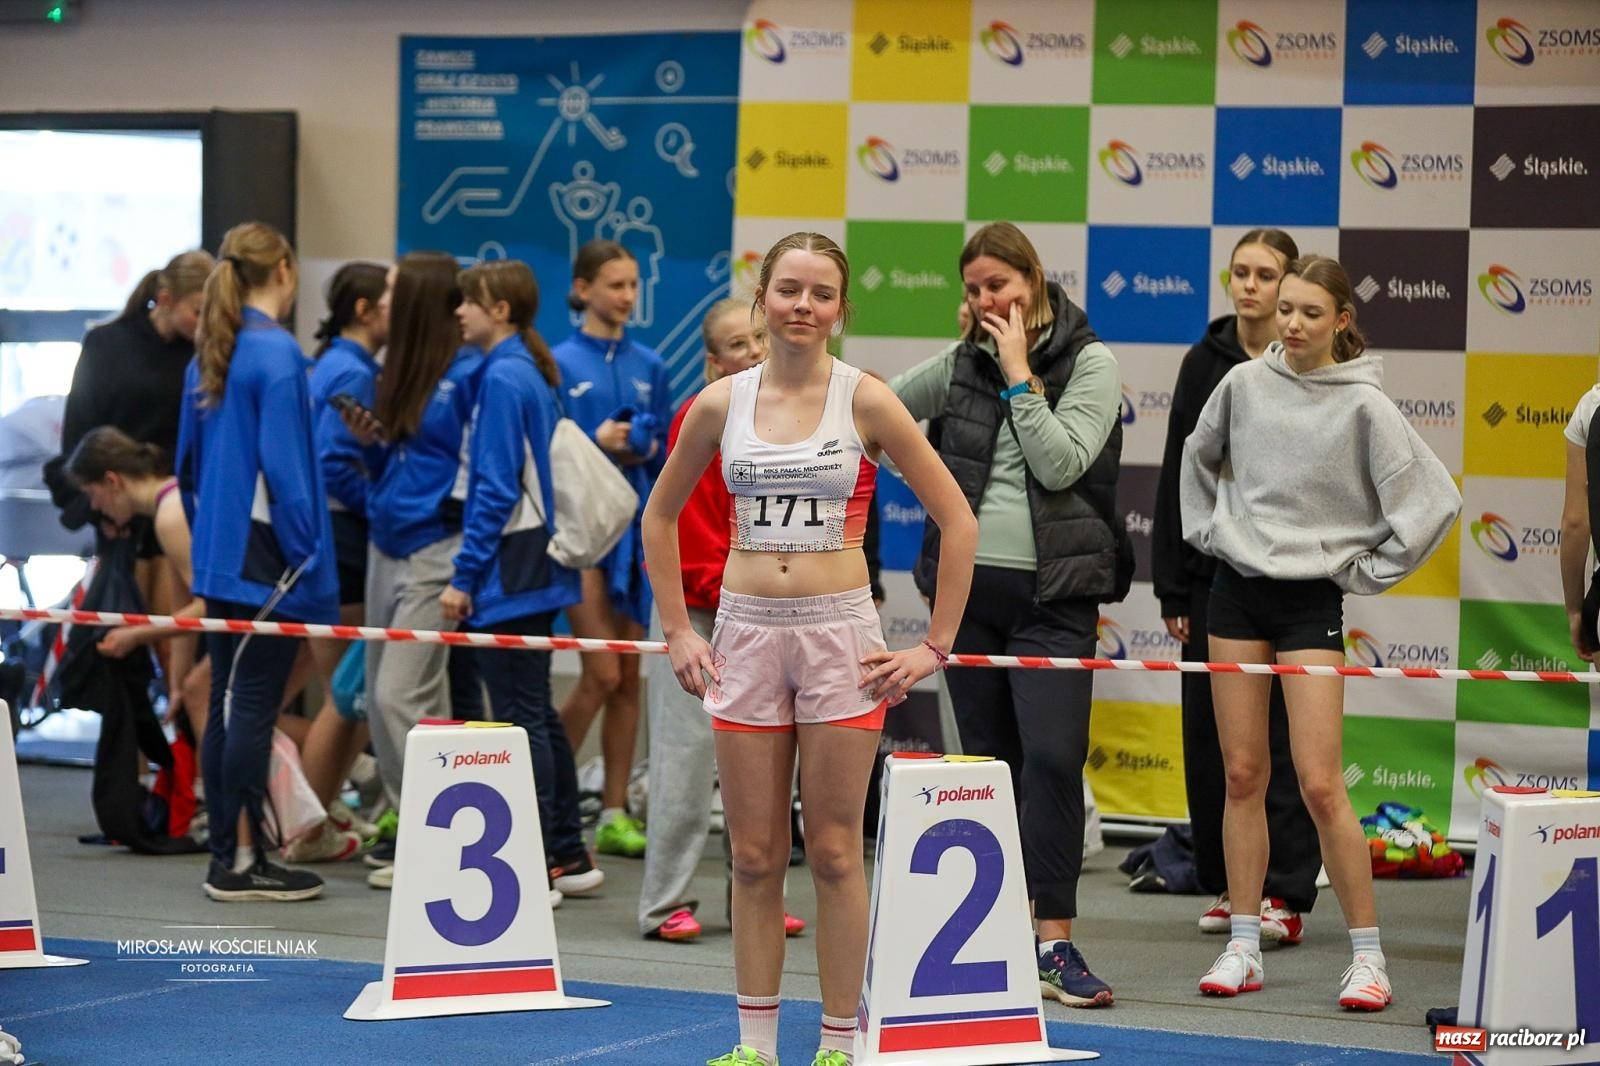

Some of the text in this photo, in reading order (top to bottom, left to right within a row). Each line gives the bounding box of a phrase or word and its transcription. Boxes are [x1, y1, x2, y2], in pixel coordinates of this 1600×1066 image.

[1026, 32, 1085, 49] ZSOMS
[1276, 32, 1337, 50] ZSOMS
[1538, 29, 1600, 47] ZSOMS
[902, 150, 960, 167] ZSOMS
[1146, 152, 1206, 170] ZSOMS
[1401, 154, 1463, 172] ZSOMS
[1529, 278, 1592, 297] ZSOMS
[780, 466, 802, 474] PAŁAC
[803, 464, 843, 473] MŁODZIEŻY
[754, 495, 824, 527] 171
[1387, 644, 1449, 664] ZSOMS
[453, 750, 512, 768] polanik
[937, 785, 995, 806] polanik
[425, 782, 520, 946] 3
[910, 819, 1008, 998] 2
[1536, 857, 1600, 1044] 1
